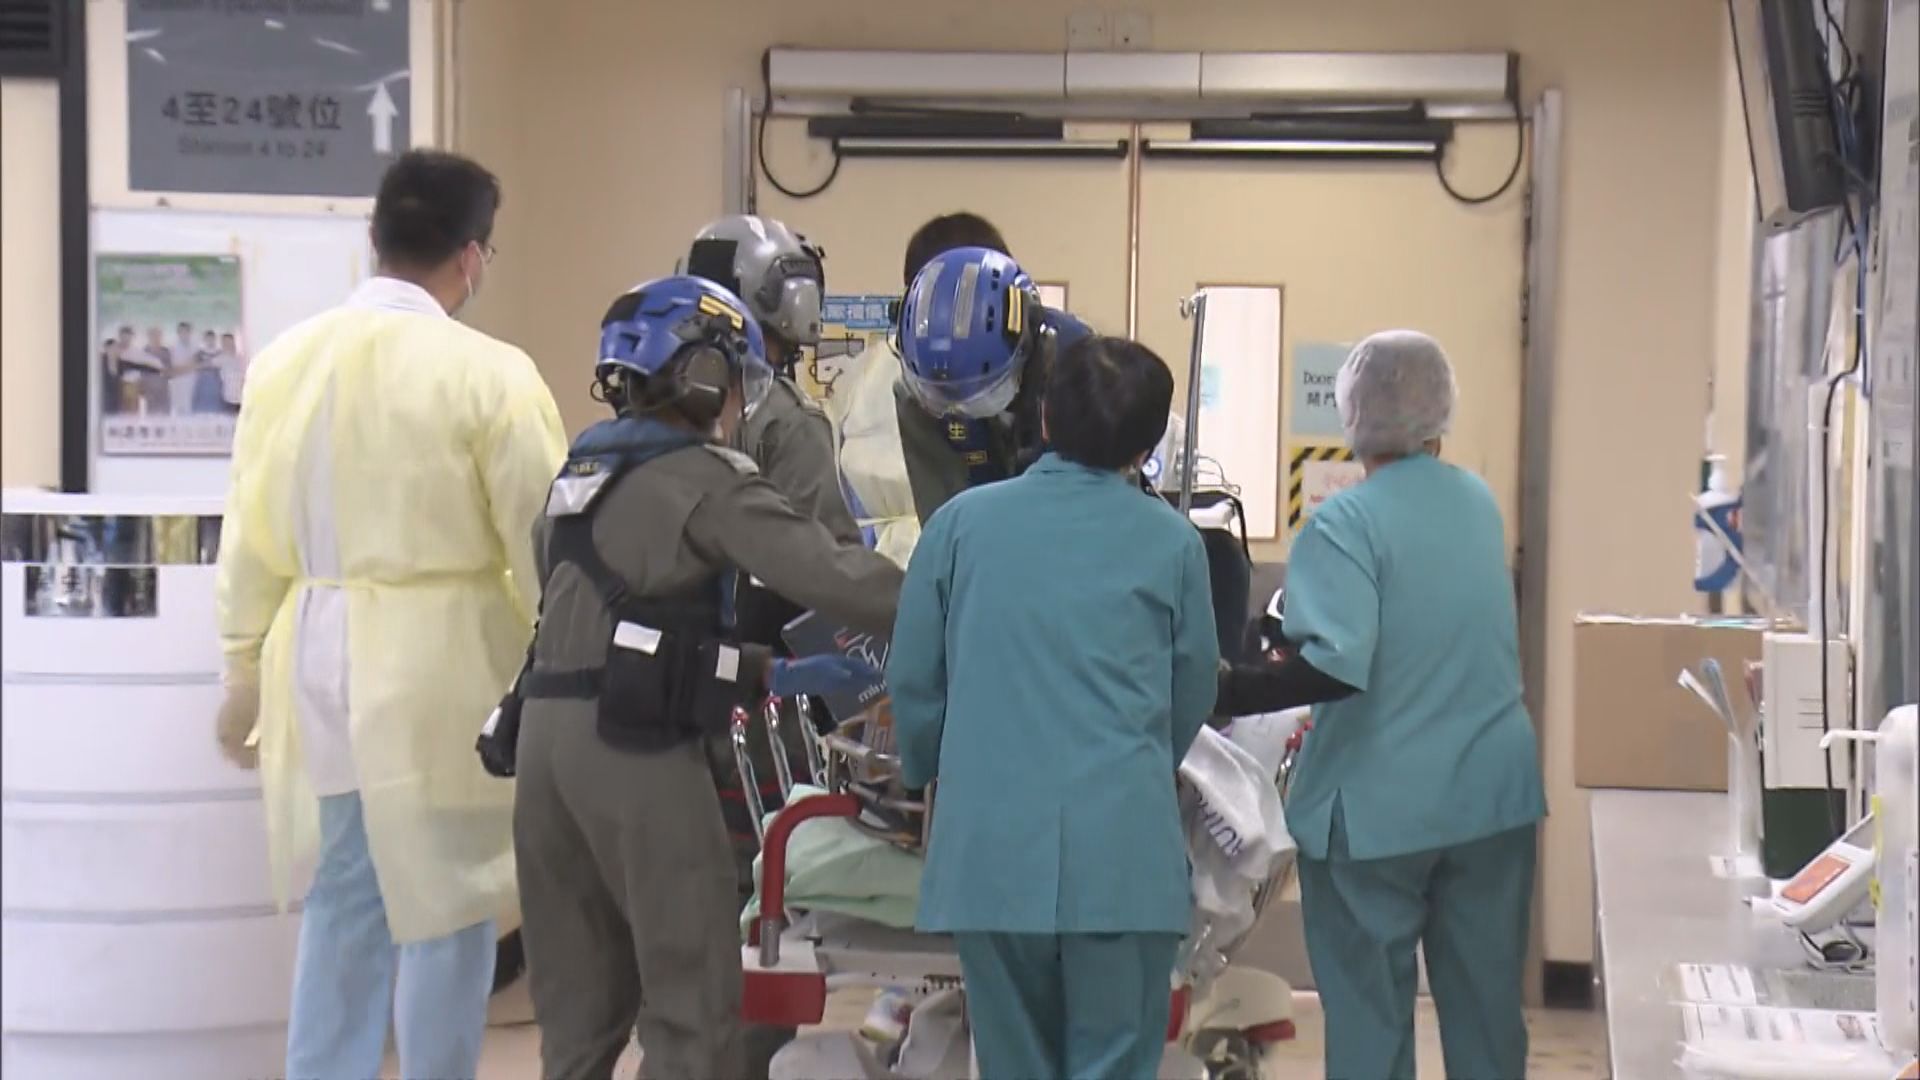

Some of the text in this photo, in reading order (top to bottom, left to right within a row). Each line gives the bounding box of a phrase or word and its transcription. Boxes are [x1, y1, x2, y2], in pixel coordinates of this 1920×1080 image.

[162, 92, 342, 130] 4至24號位
[303, 140, 328, 159] 24
